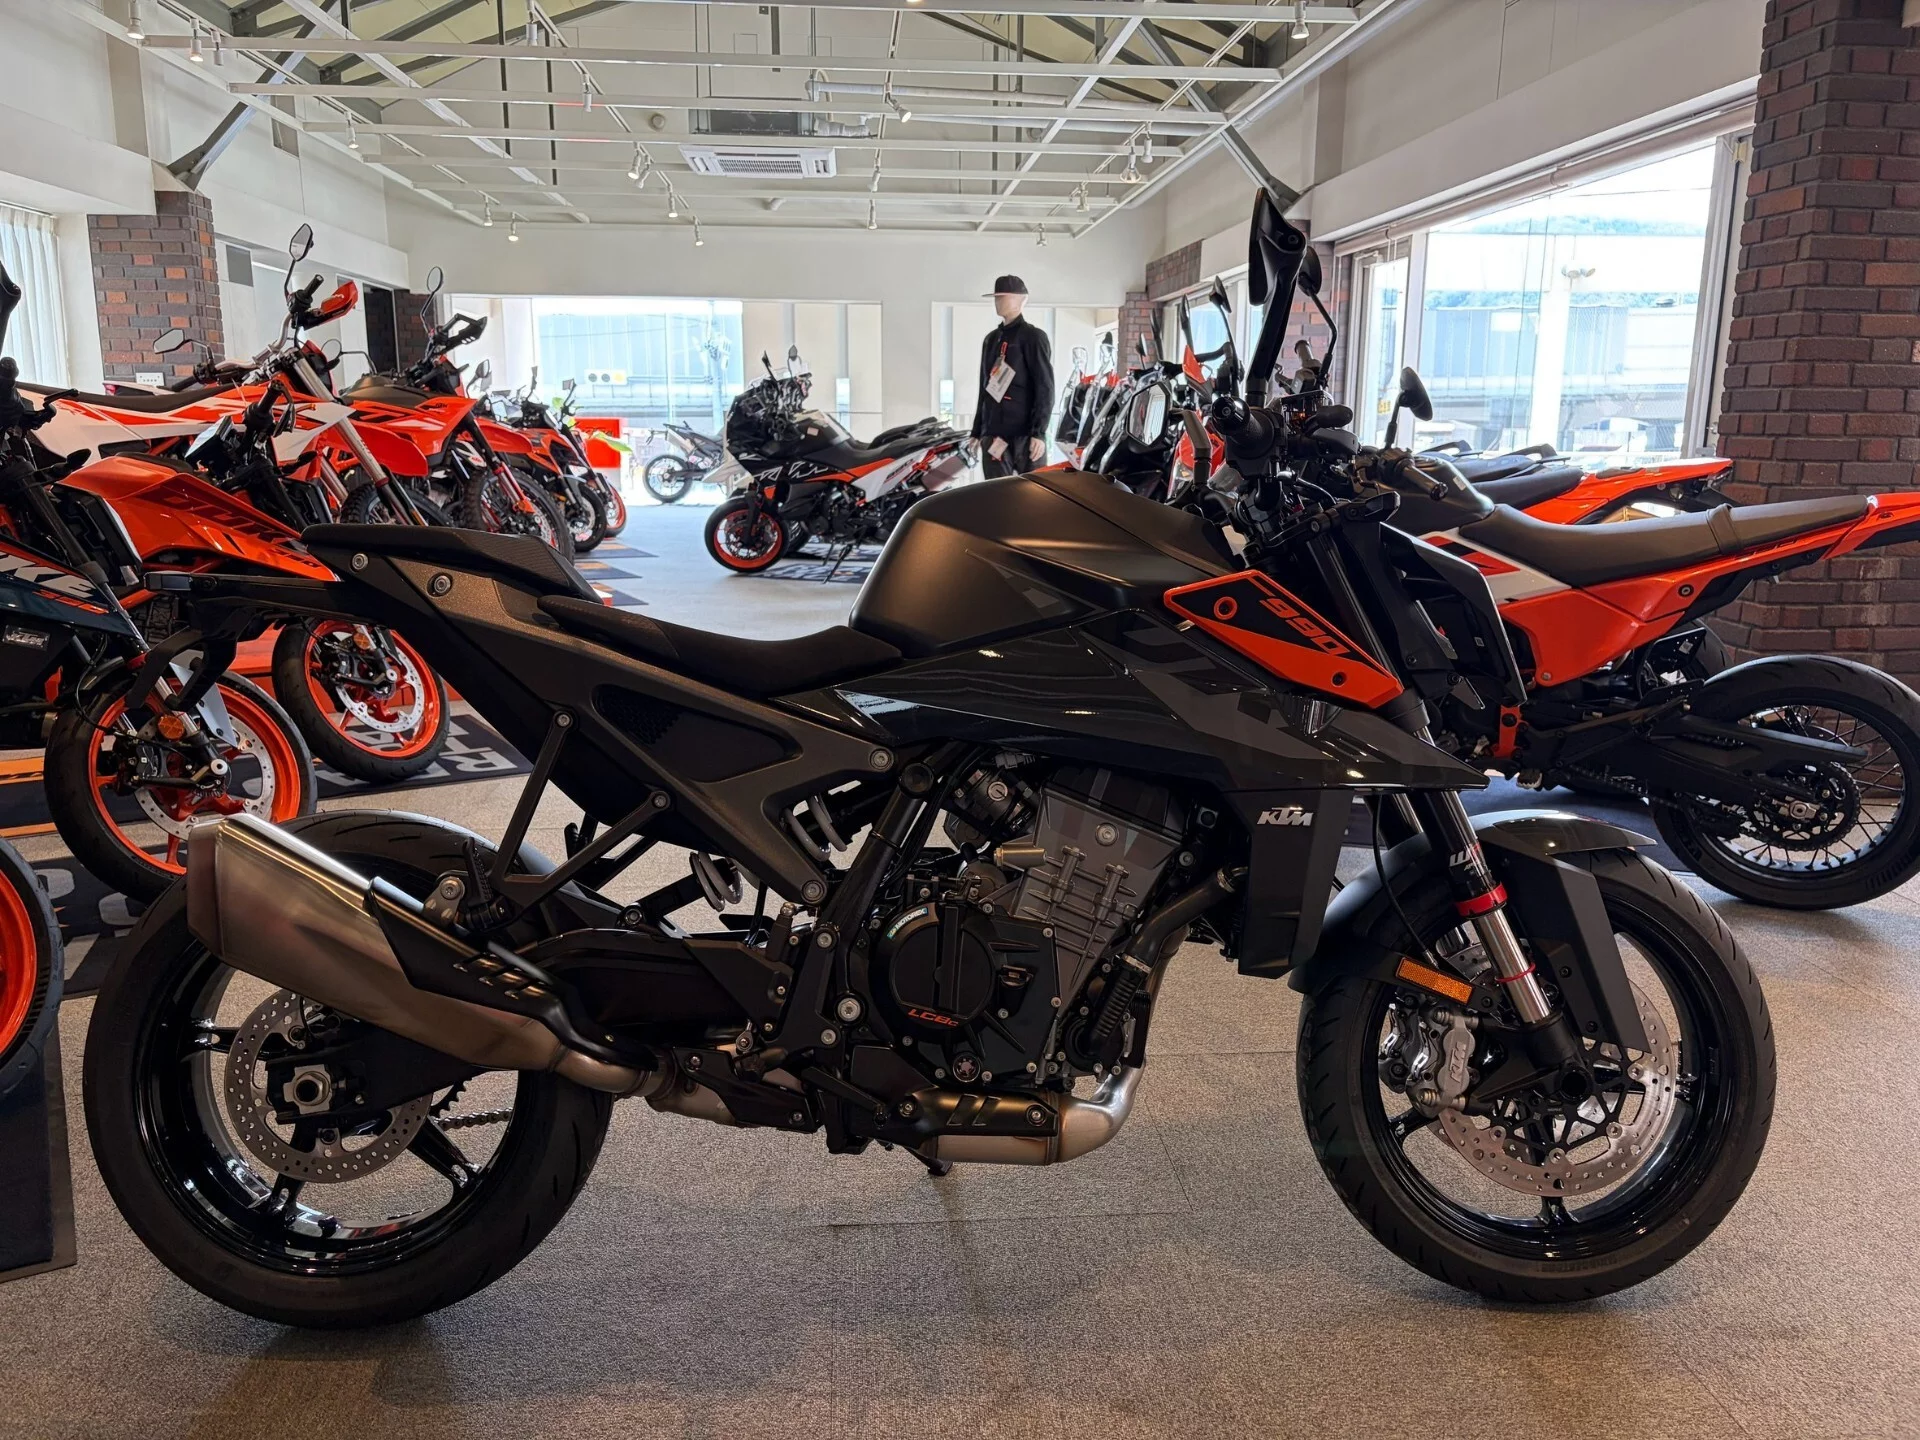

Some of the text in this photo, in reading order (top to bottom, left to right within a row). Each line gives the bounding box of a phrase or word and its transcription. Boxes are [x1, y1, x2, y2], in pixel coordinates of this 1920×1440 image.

[1258, 597, 1350, 656] 990
[1256, 806, 1314, 827] KTM
[1449, 1041, 1467, 1084] KTM
